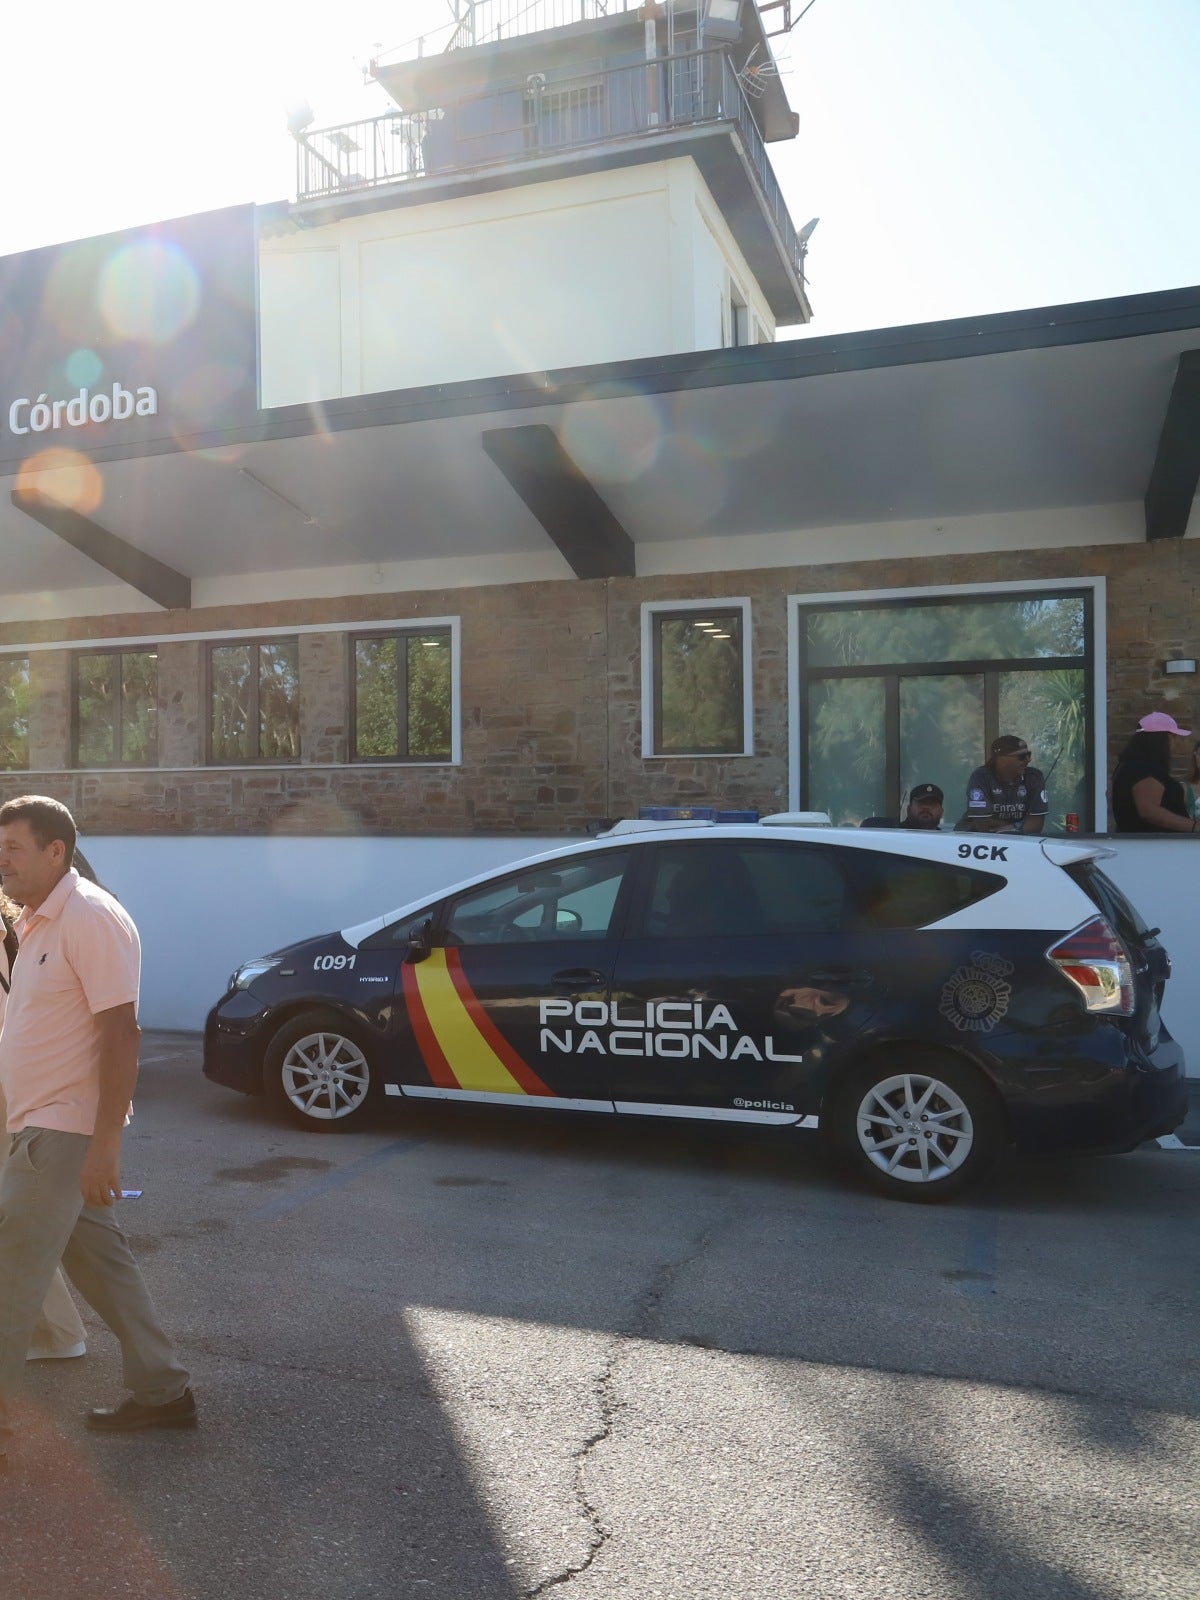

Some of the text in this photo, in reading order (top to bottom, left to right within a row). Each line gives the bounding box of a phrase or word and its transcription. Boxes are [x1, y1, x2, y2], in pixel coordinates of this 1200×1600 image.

[9, 387, 157, 434] Córdoba
[957, 843, 1009, 862] 9CK
[540, 1028, 803, 1063] NACIONAL
[733, 1097, 795, 1111] @policia
